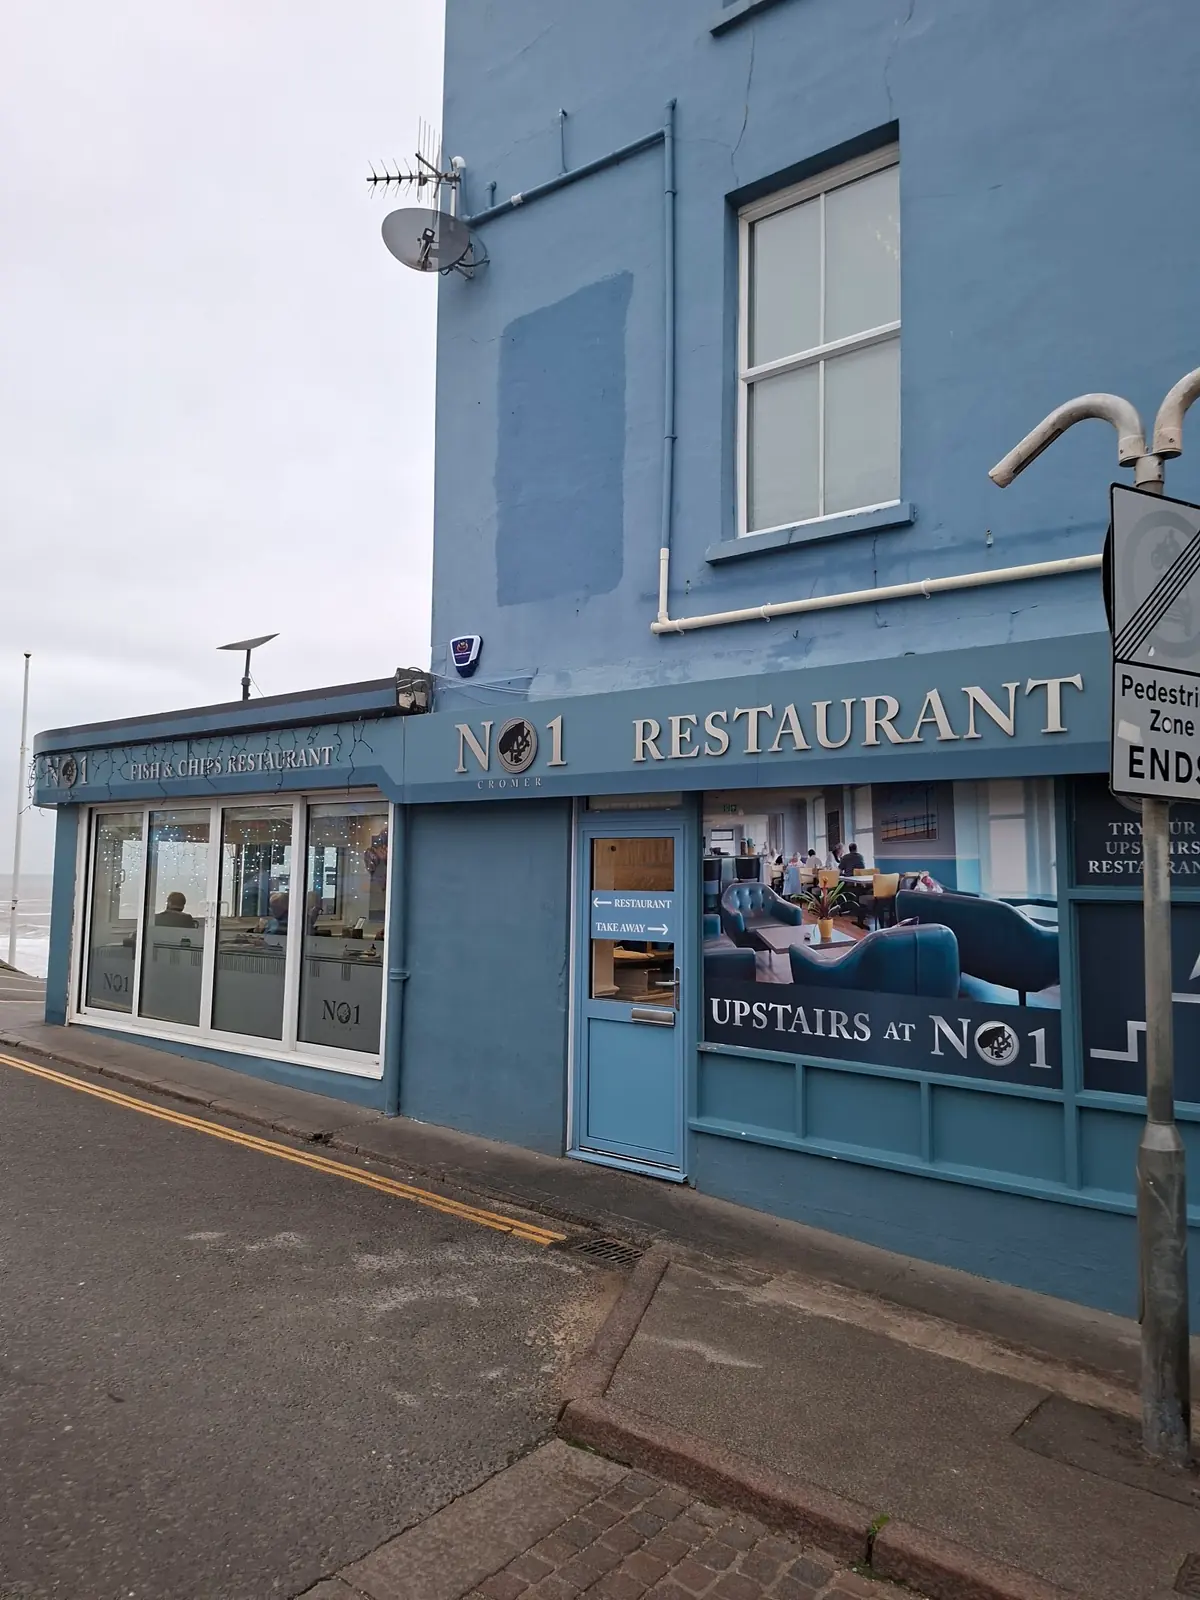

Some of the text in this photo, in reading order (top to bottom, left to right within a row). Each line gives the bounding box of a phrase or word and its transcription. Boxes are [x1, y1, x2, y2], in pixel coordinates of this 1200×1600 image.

[1122, 674, 1200, 708] Pedestri
[632, 673, 1083, 763] RESTAURANT
[1150, 709, 1195, 737] Zone
[131, 745, 334, 780] FISH & CHIPS RESTAURANT
[1129, 745, 1200, 784] END
[478, 777, 542, 789] CROMER
[1168, 821, 1197, 835] UR
[1105, 841, 1200, 855] UPSIRS
[614, 899, 672, 909] RESTAURANT
[596, 922, 645, 933] TAKE AWAY
[710, 997, 871, 1042] UPSTAIRS
[883, 1021, 916, 1042] AT
